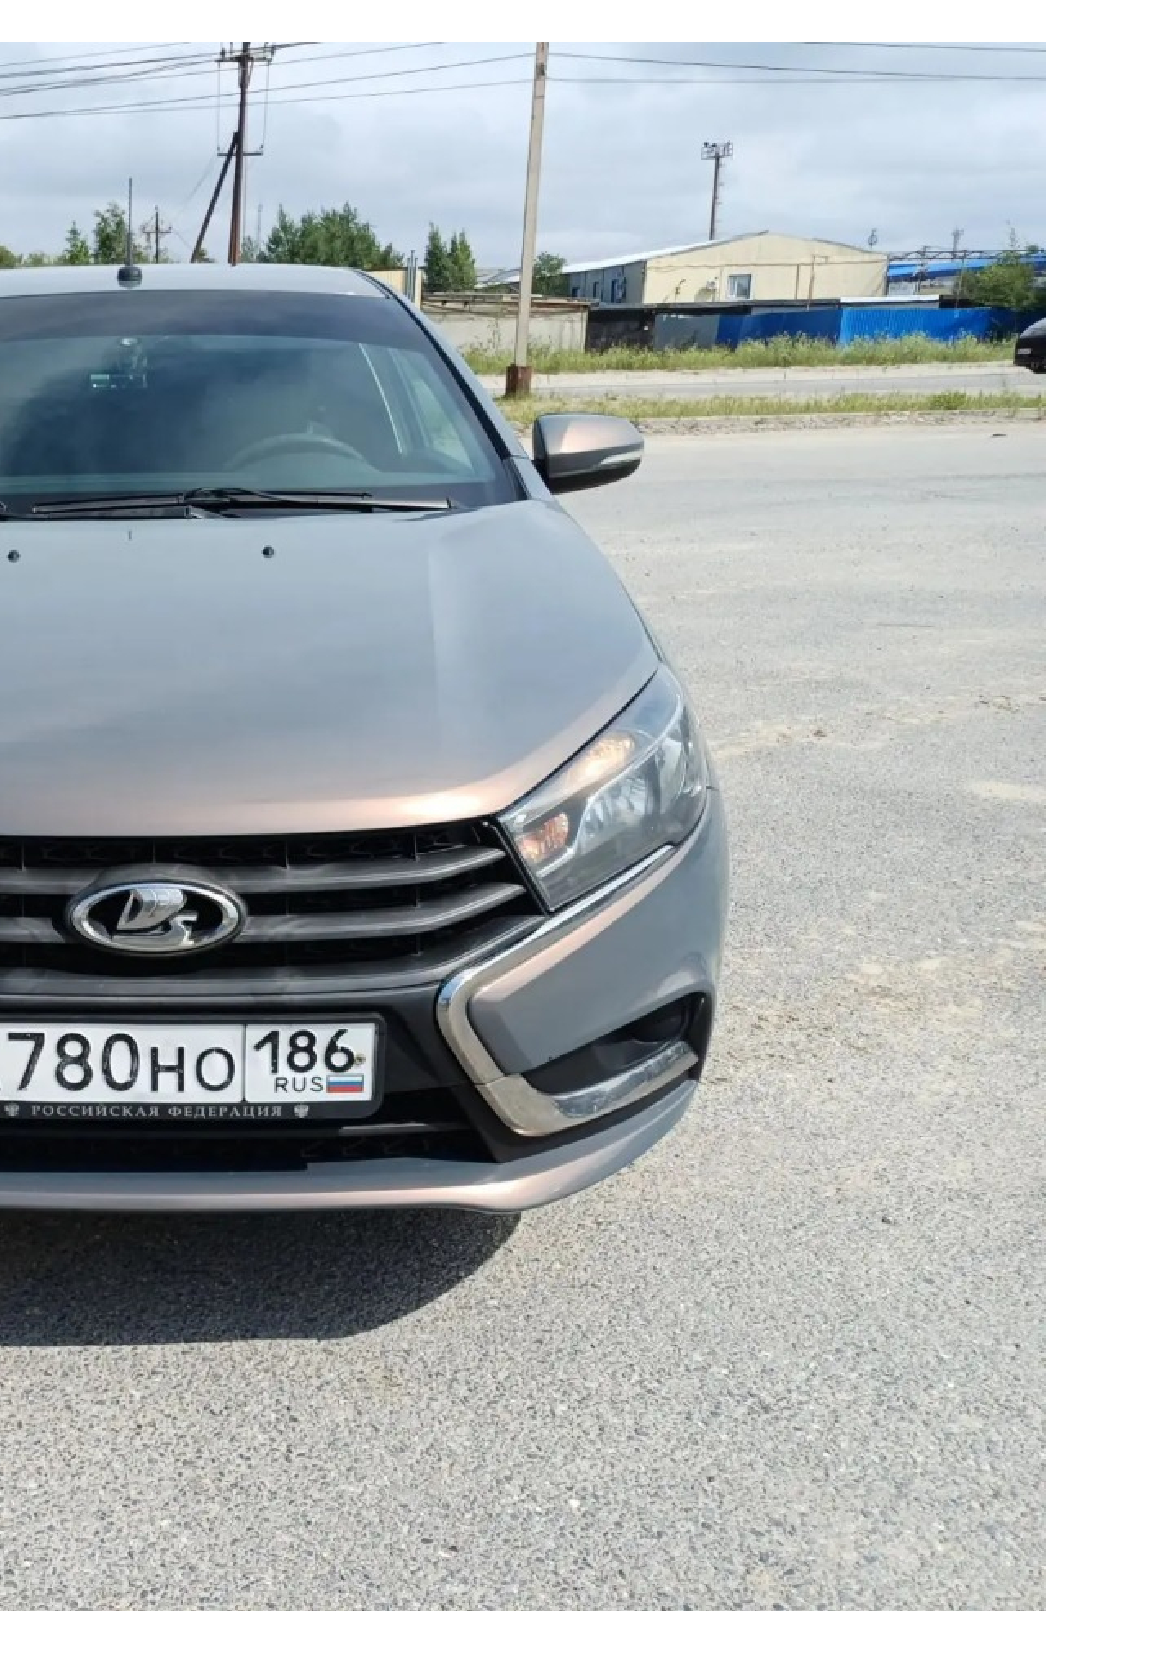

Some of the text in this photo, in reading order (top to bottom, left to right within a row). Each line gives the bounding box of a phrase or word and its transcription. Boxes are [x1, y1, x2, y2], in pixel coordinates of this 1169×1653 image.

[253, 1028, 355, 1074] 186
[274, 1076, 324, 1093] RUS
[31, 1102, 283, 1119] РОССИЙСКАЯ ФЕДЕРАЦИЯ
